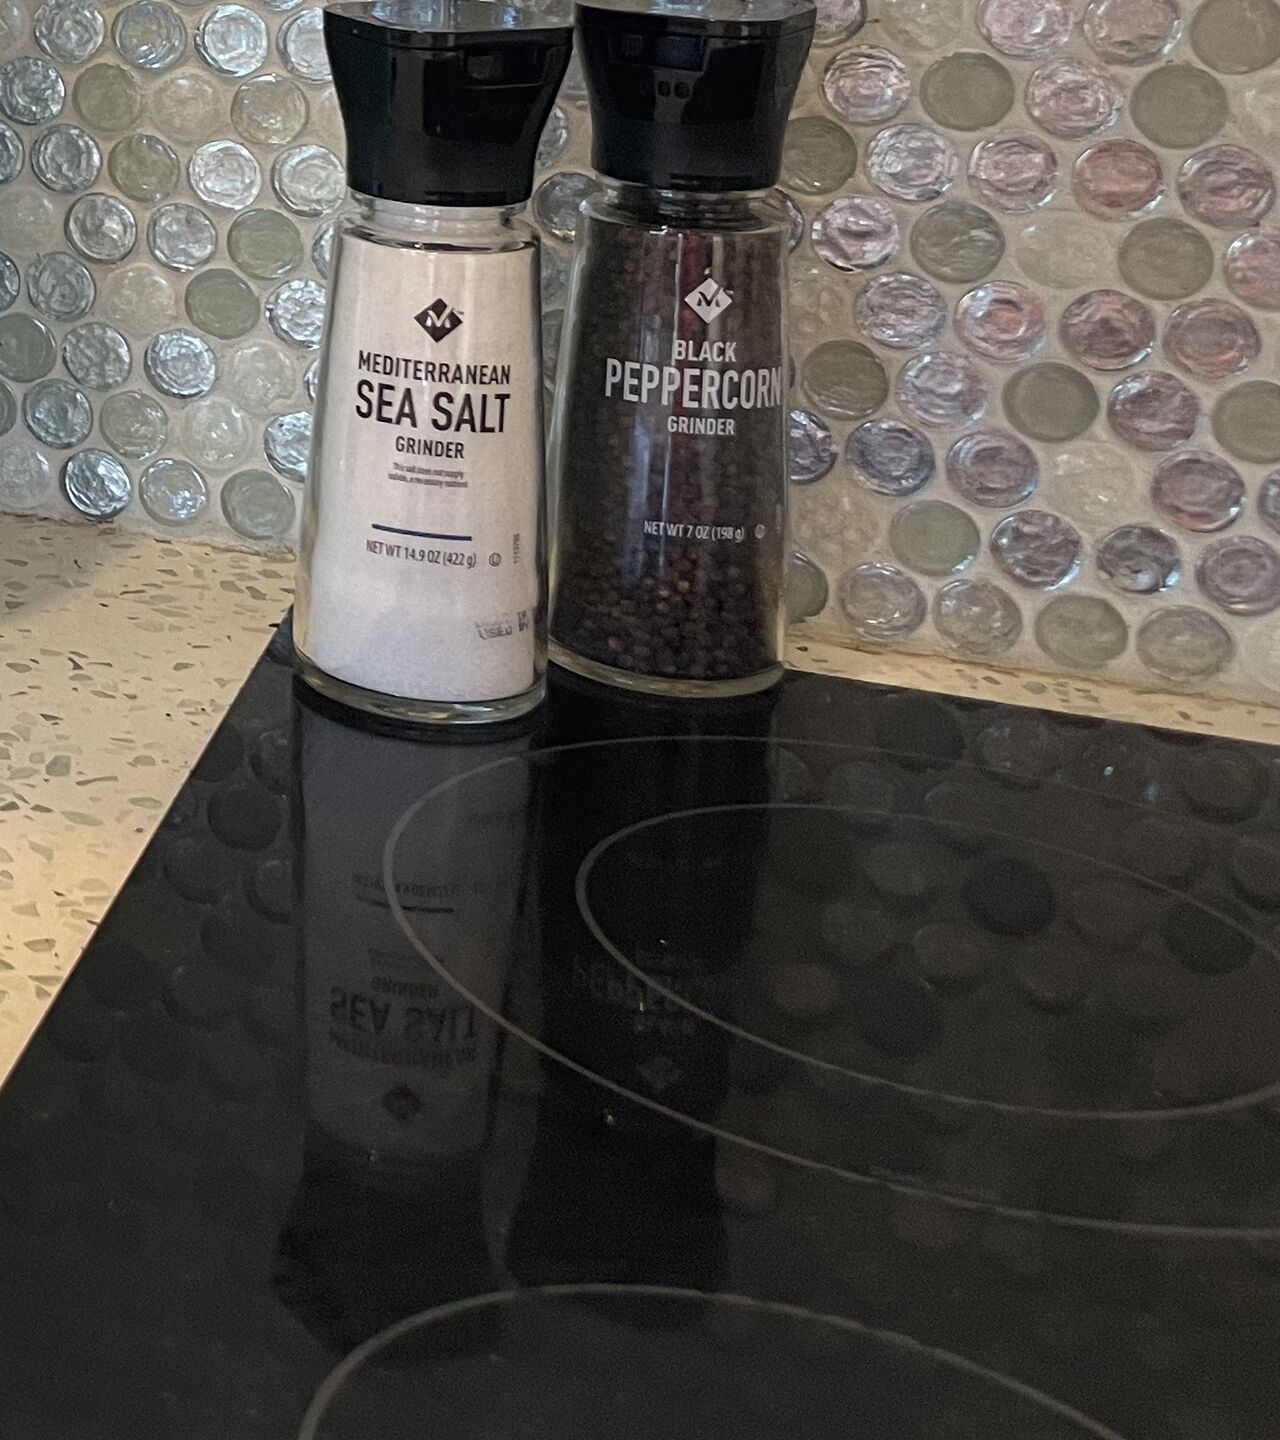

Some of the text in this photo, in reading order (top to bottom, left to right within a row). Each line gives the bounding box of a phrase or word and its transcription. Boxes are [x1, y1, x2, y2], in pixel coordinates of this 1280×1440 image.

[675, 339, 736, 362] BLACK
[358, 350, 511, 385] MEDITERRANEAN
[605, 357, 782, 410] PEPPERCORN
[355, 379, 511, 433] SEA SALT
[667, 415, 735, 435] GRINDER
[395, 436, 465, 459] GRINDER
[643, 520, 665, 535] NET
[666, 522, 685, 538] WT
[686, 525, 693, 539] 7
[695, 525, 709, 539] OZ
[366, 539, 384, 555] NET
[385, 543, 402, 558] WT
[404, 547, 426, 562] 14.9
[427, 550, 441, 564] OZ
[443, 551, 465, 566] (422
